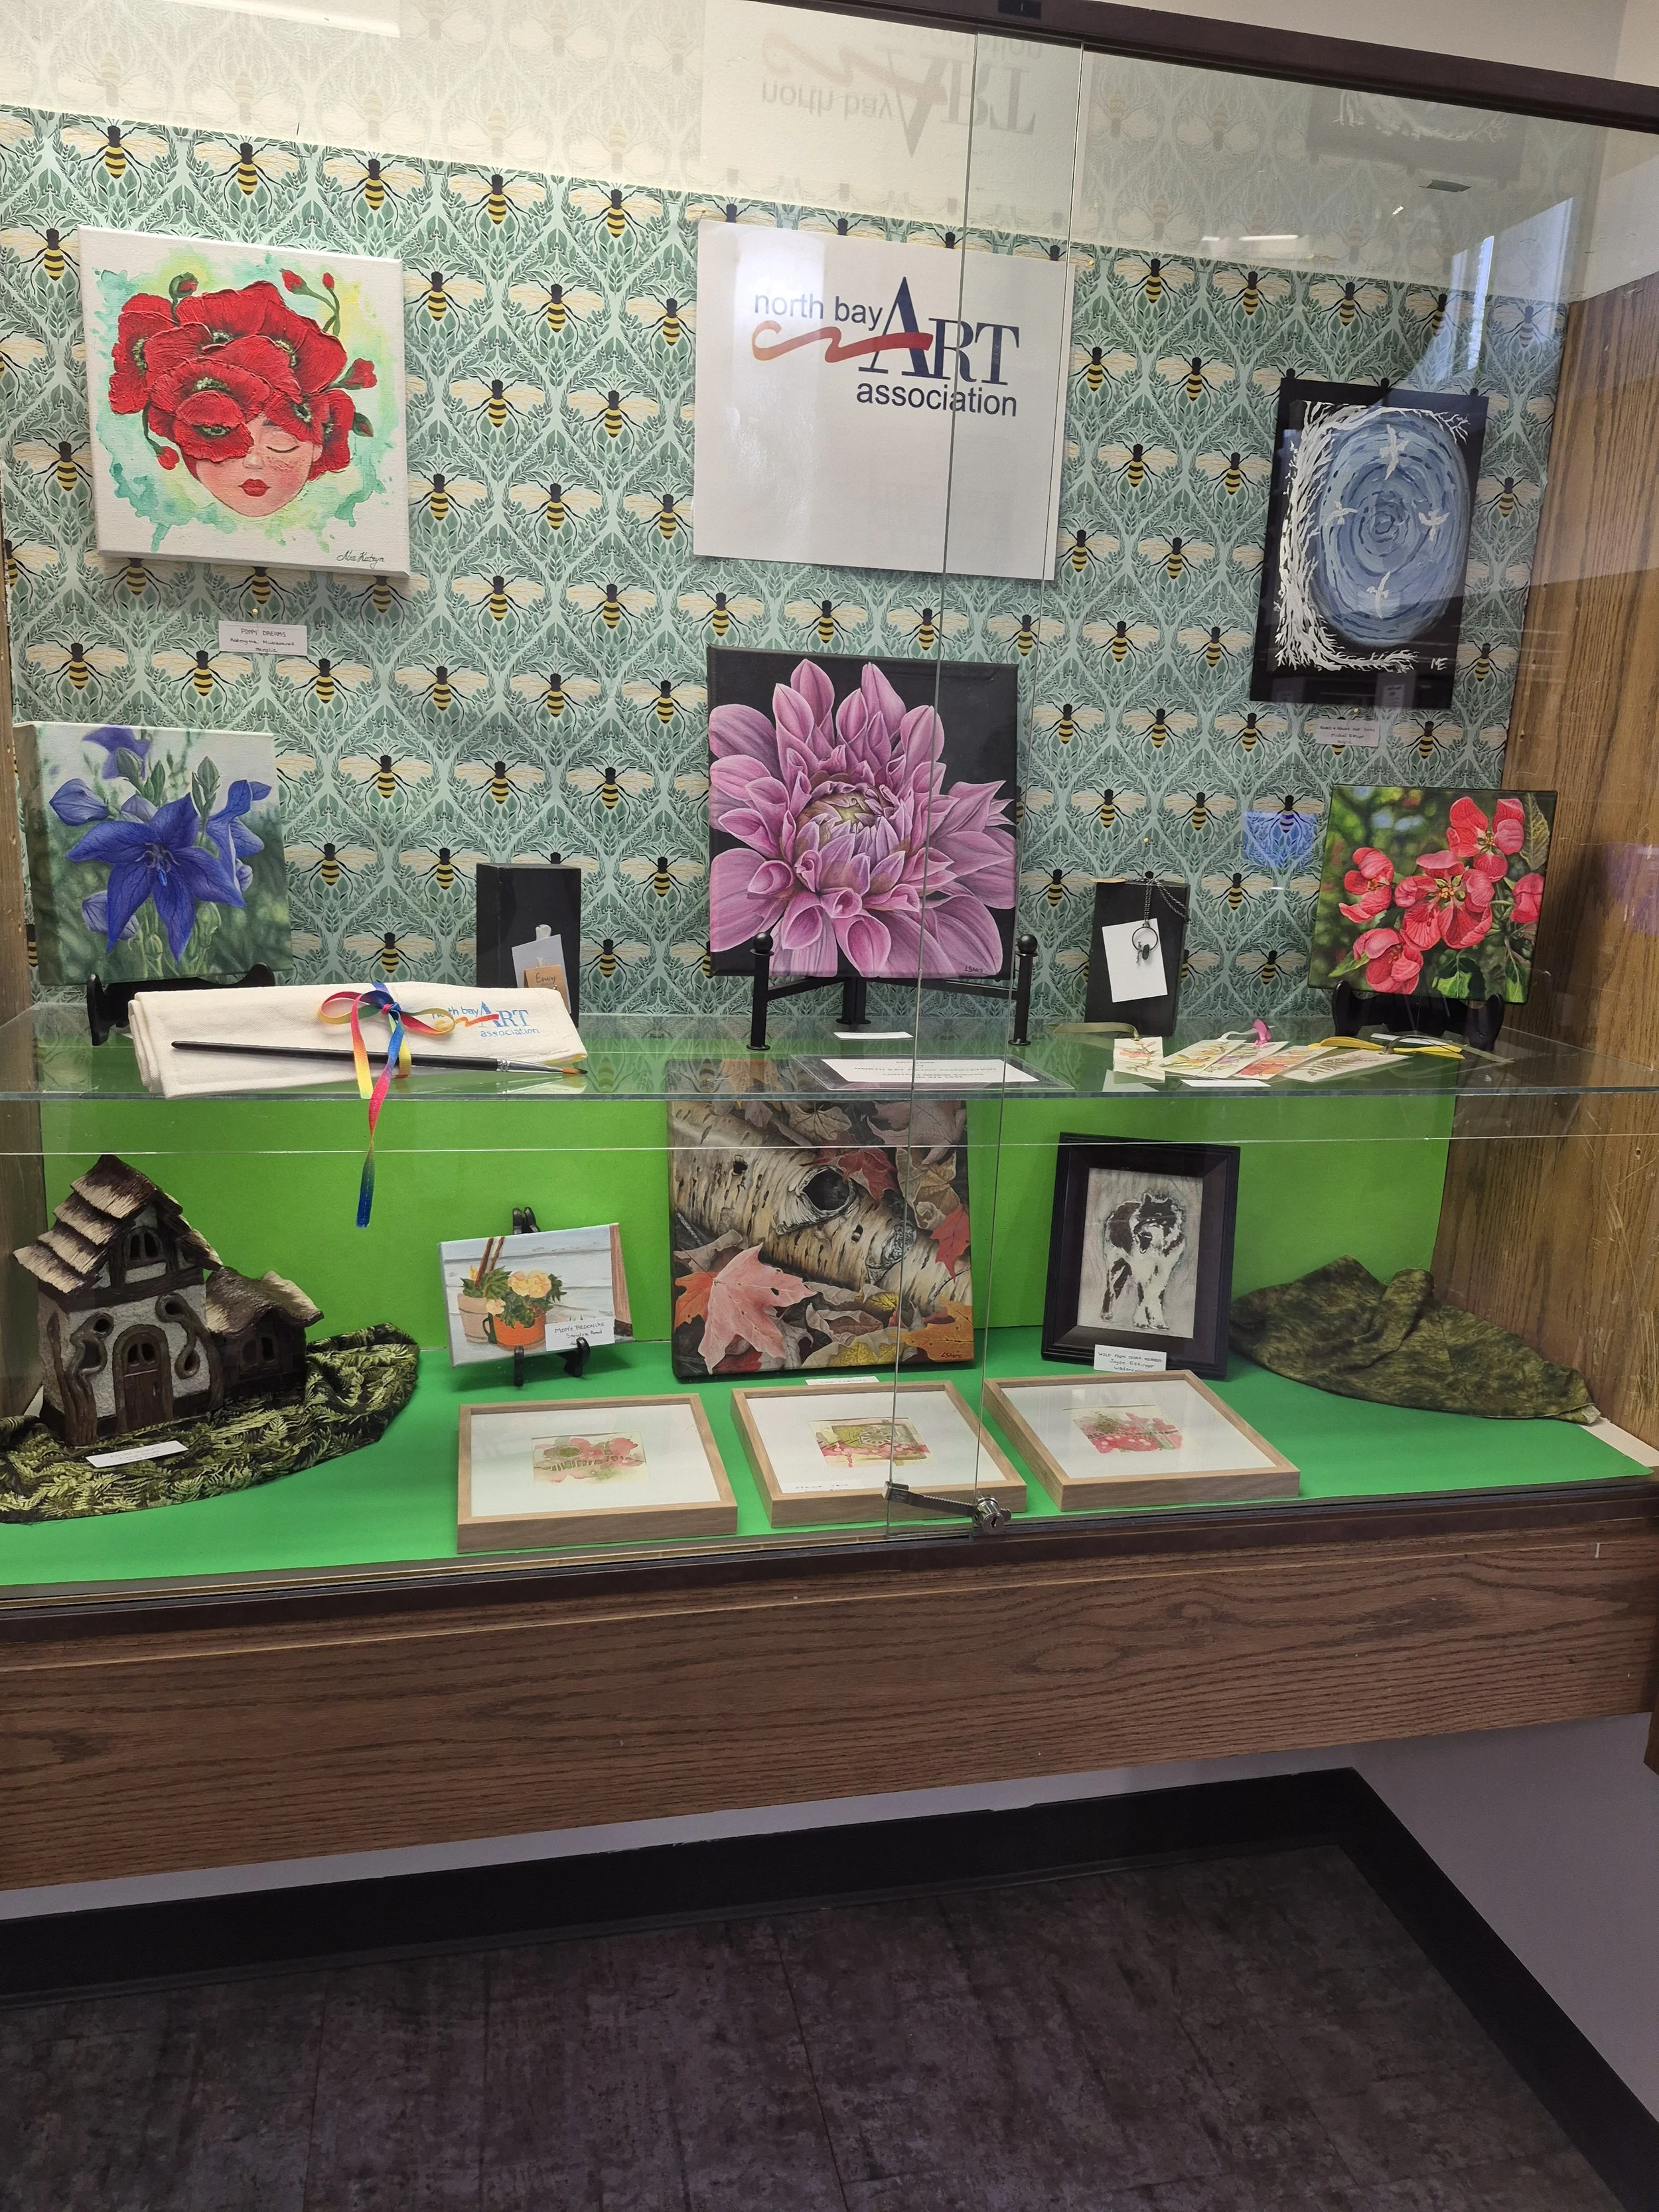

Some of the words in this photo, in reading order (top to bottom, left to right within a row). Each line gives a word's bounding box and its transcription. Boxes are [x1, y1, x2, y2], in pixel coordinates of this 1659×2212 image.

[754, 293, 824, 320] north
[834, 296, 883, 331] bay
[858, 276, 1019, 386] ART
[856, 382, 1017, 417] association
[1430, 657, 1449, 671] ME
[461, 1006, 478, 1017] bay
[478, 1000, 530, 1028] ART
[480, 1028, 540, 1038] association
